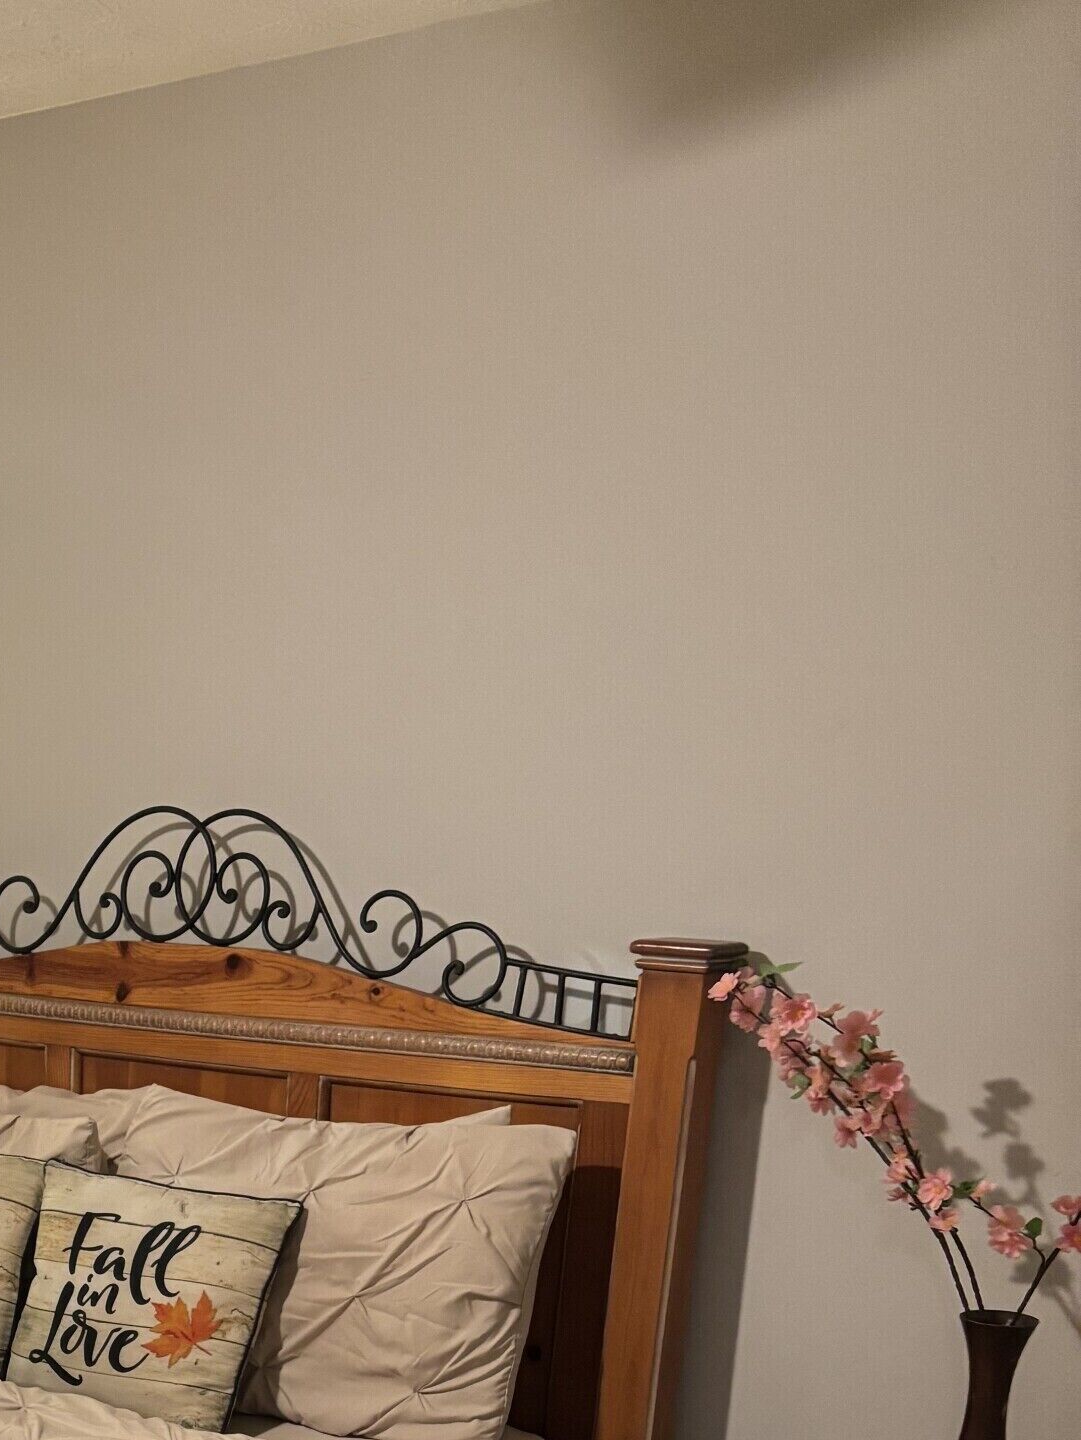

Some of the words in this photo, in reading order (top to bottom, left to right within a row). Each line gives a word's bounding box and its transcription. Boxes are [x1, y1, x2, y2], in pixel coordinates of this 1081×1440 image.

[62, 1211, 202, 1305] Fall
[77, 1273, 117, 1314] in
[28, 1281, 149, 1386] Love
